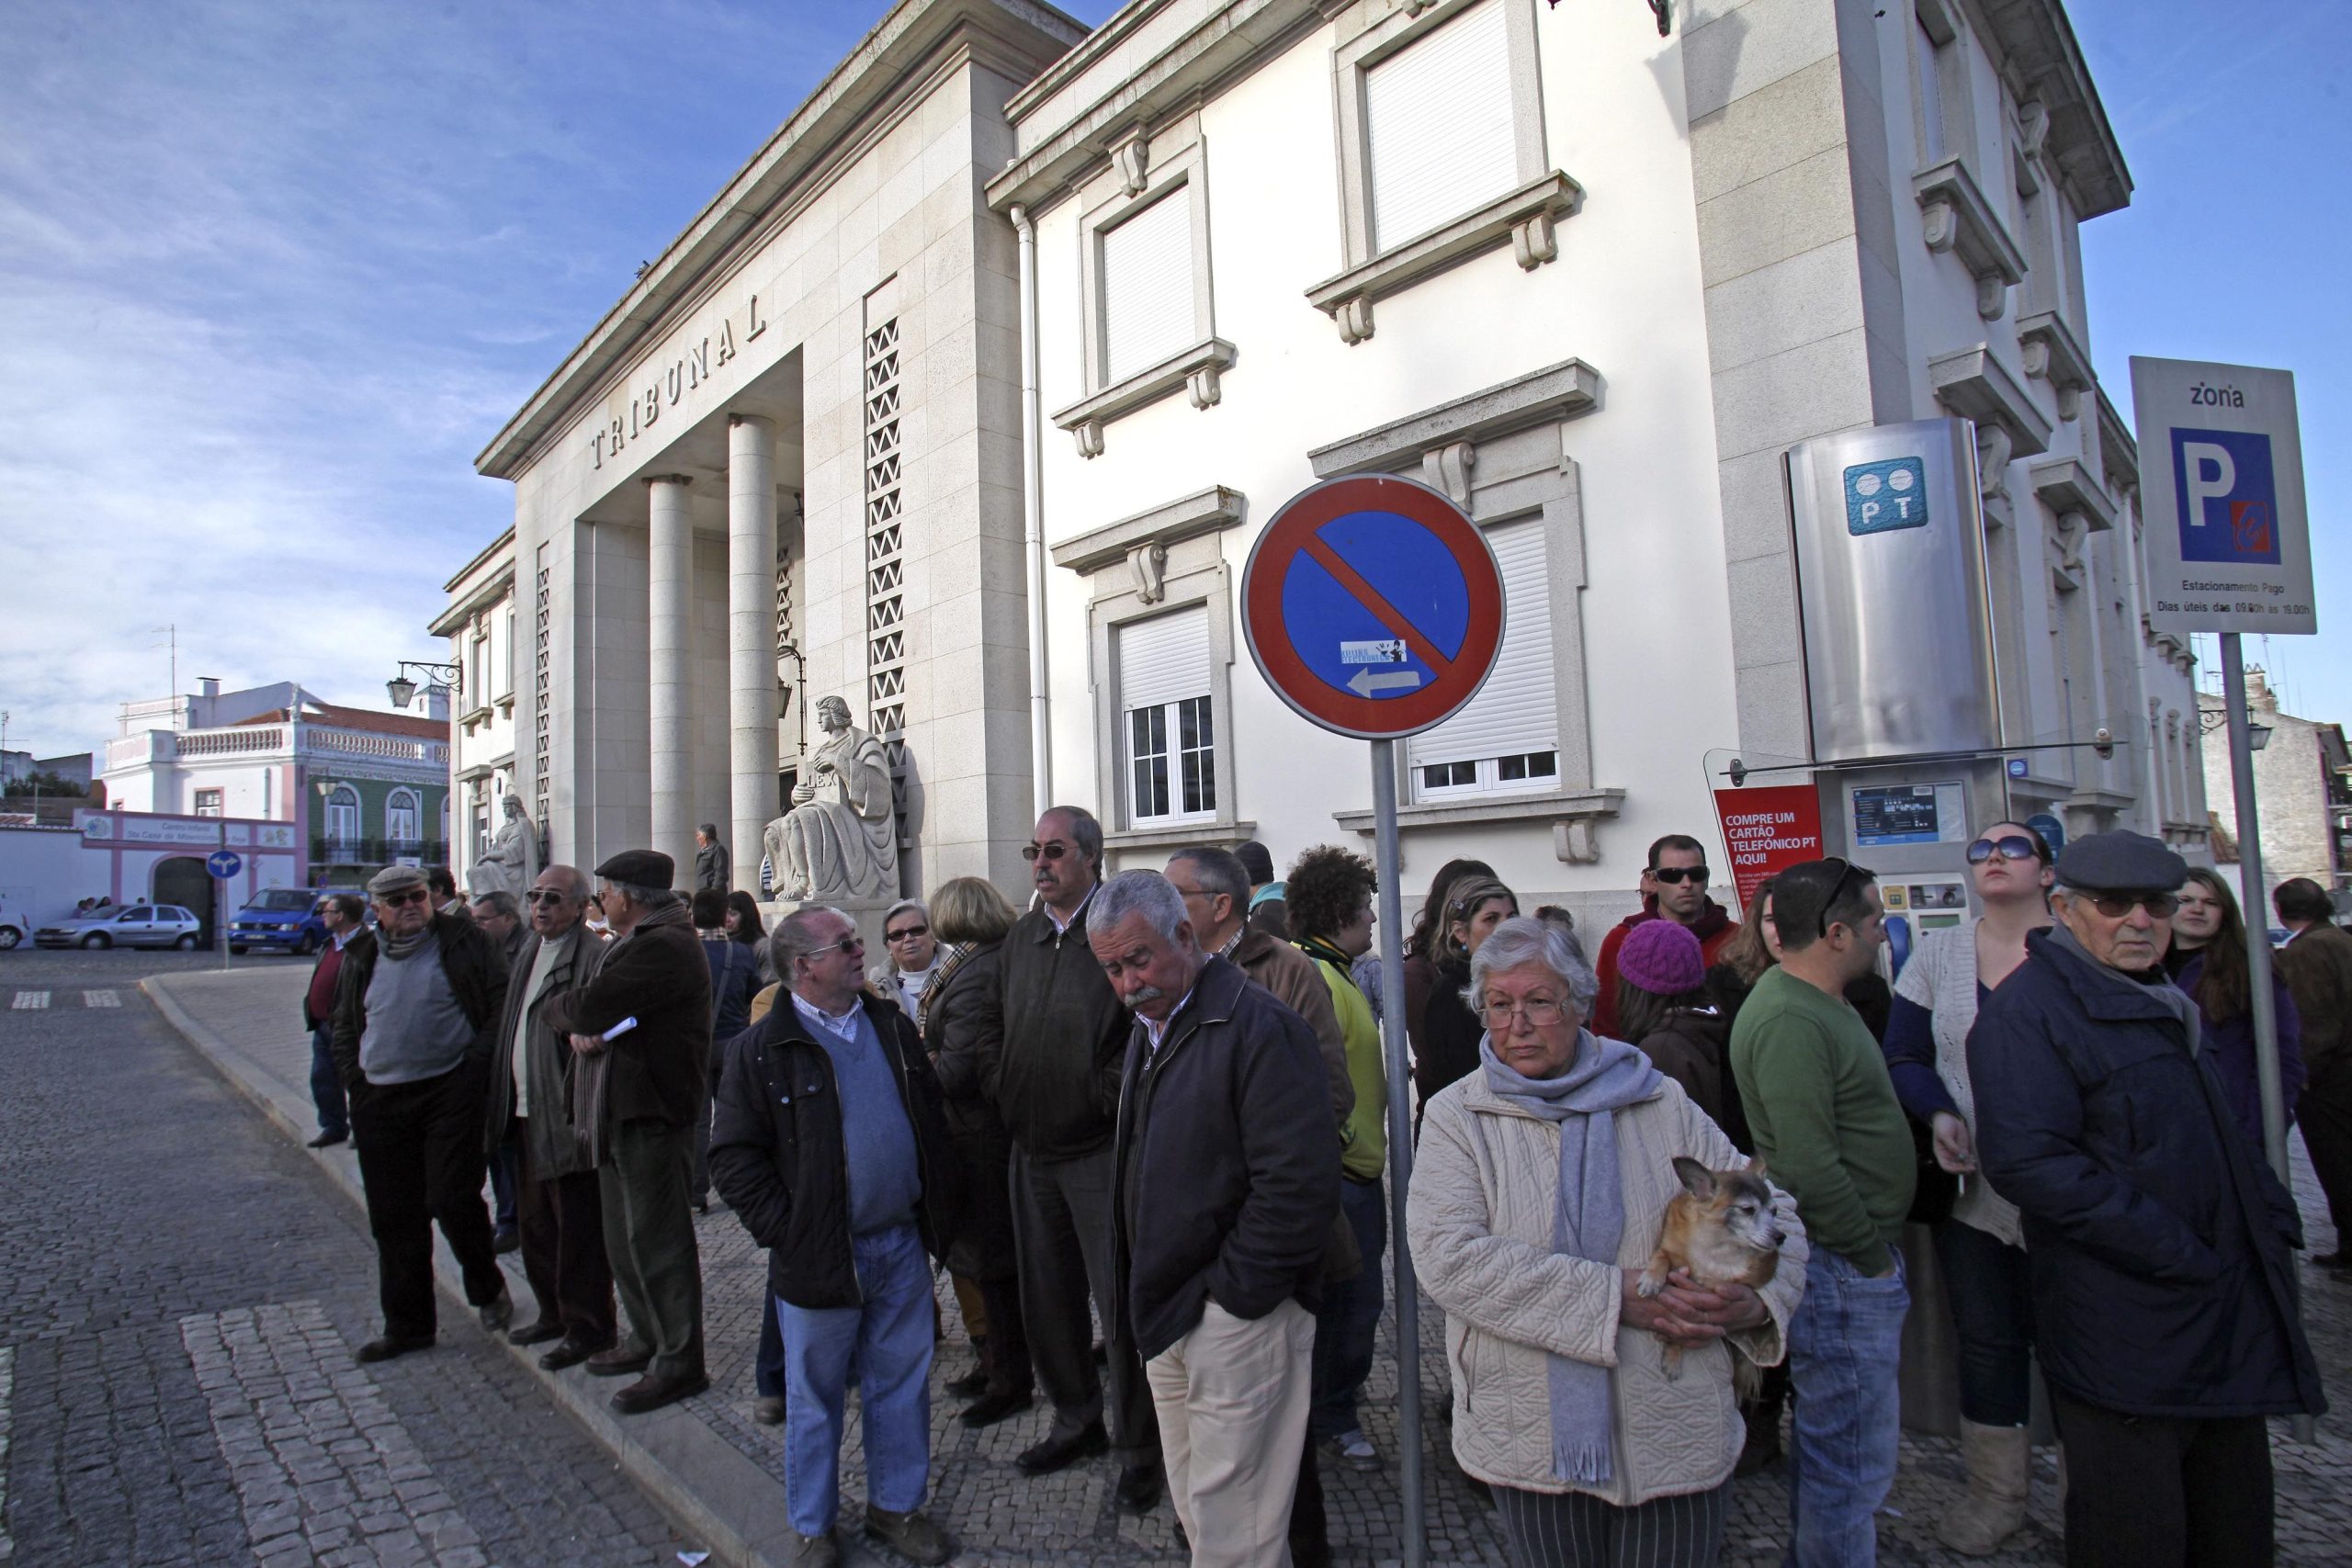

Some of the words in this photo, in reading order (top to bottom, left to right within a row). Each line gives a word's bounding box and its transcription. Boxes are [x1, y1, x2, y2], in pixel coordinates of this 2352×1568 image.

[591, 294, 766, 470] TRIBUNAL
[2190, 386, 2245, 409] zona
[2183, 442, 2236, 526] P
[2182, 580, 2258, 592] Estacionamento
[2262, 582, 2285, 595] Pago
[2157, 601, 2179, 612] Dias
[2184, 601, 2209, 613] úteis
[2212, 602, 2231, 613] das
[2283, 604, 2310, 615] 19.00h
[1725, 813, 1774, 826] COMPRE
[1775, 812, 1795, 823] UM
[1728, 824, 1775, 839] CARTÃO
[1731, 838, 1801, 852] TELEFÓNICO
[1802, 837, 1816, 848] PT
[1735, 852, 1767, 865] AQUI!
